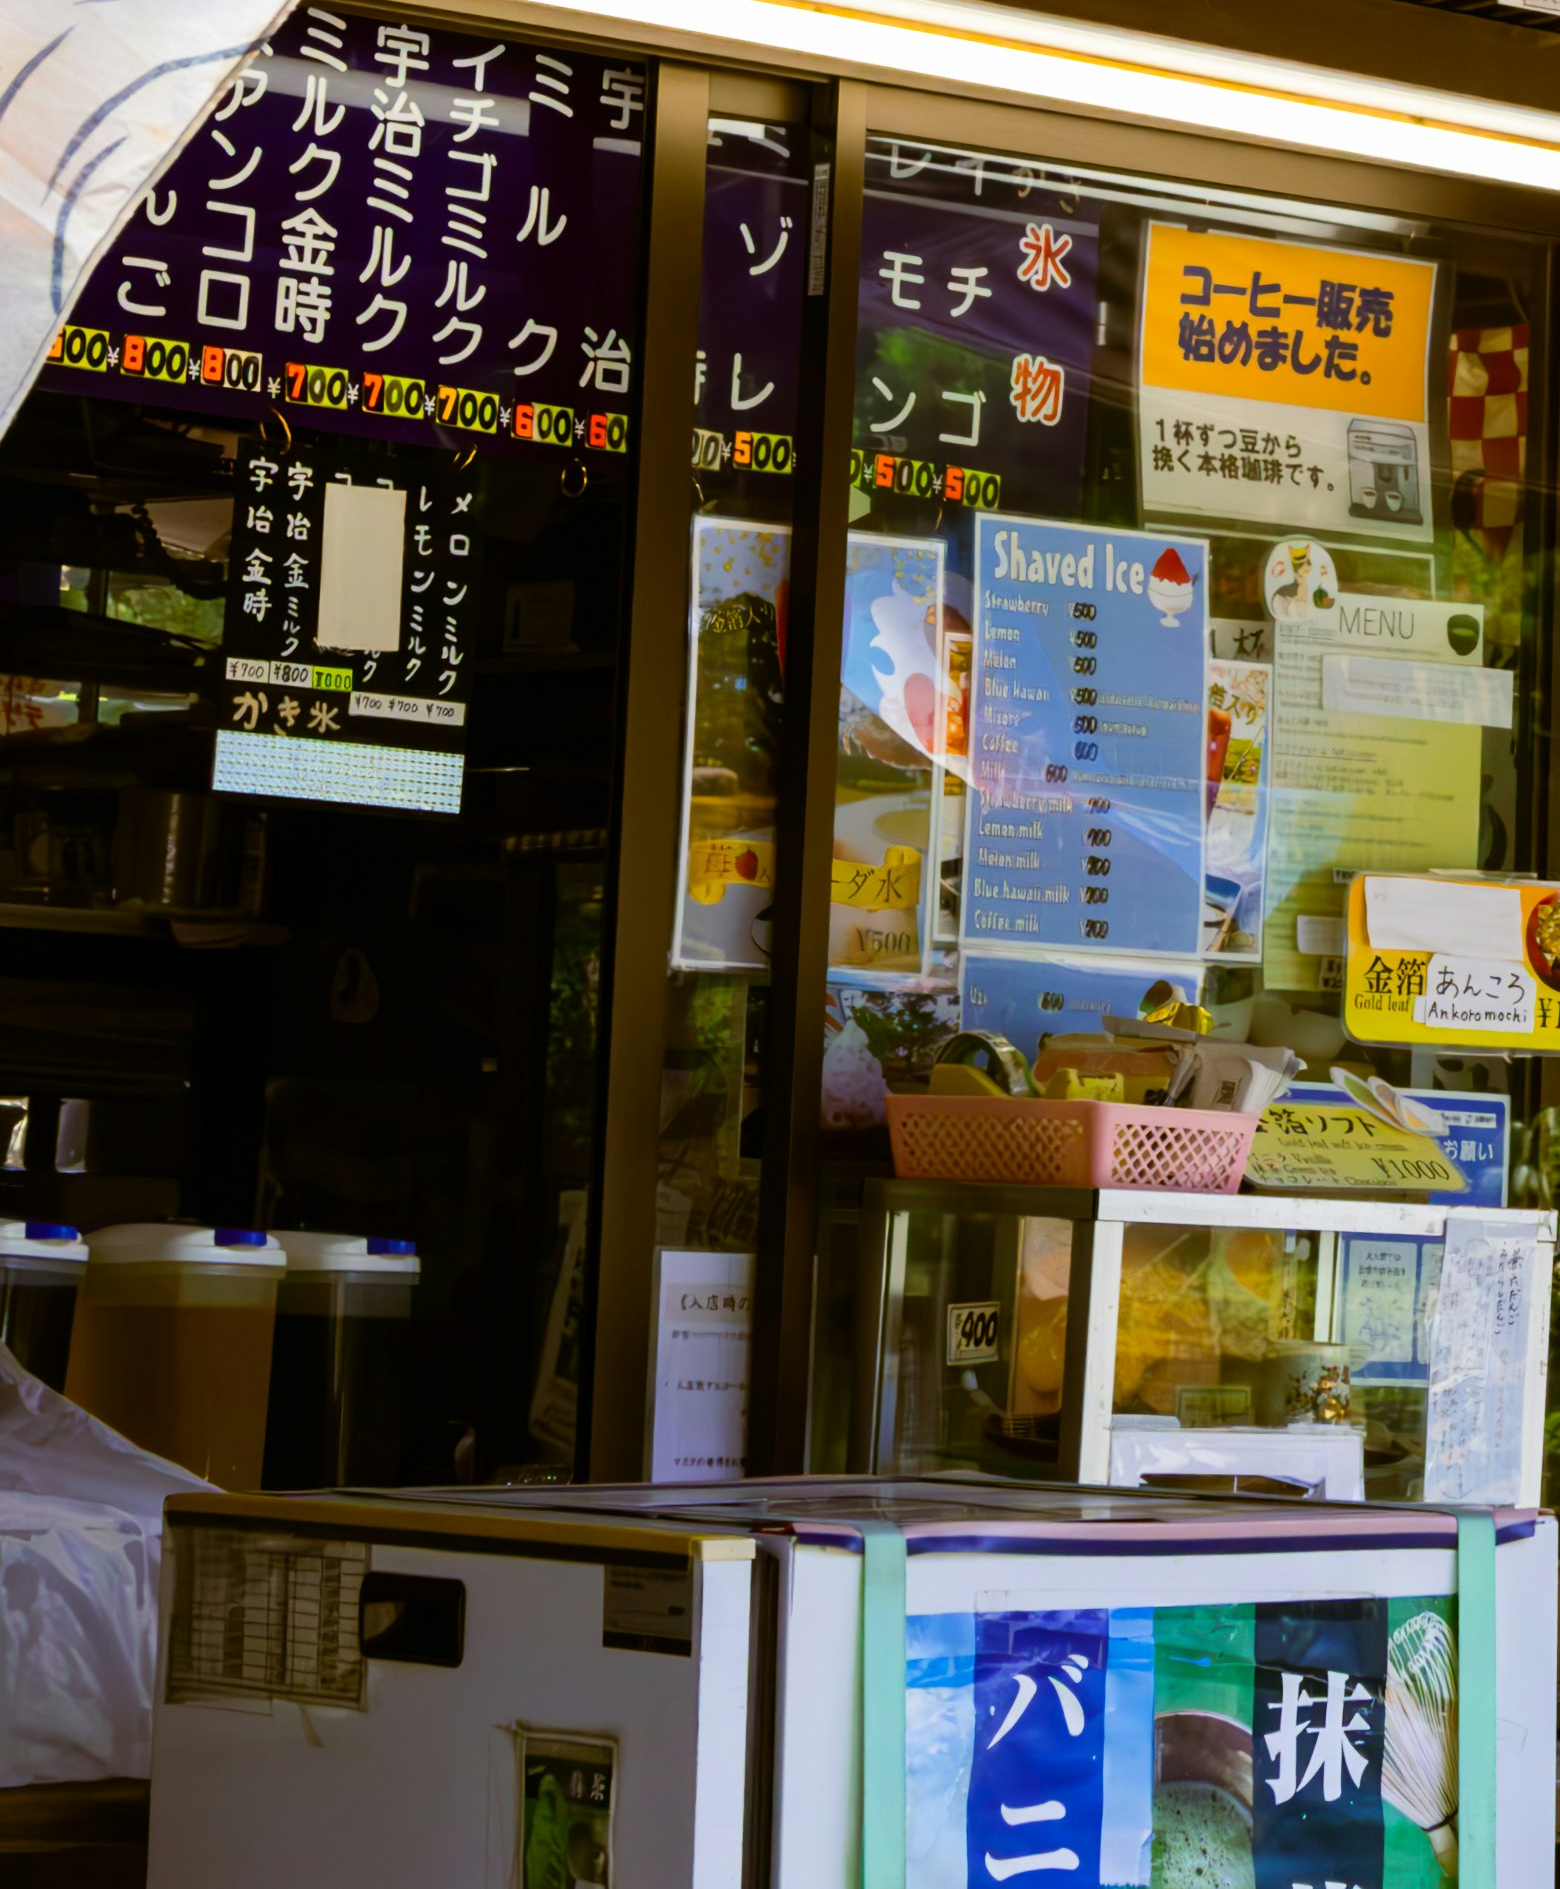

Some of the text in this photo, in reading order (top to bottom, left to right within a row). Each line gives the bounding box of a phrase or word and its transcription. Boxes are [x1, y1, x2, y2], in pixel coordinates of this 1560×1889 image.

[275, 6, 348, 344] ミルク金時
[355, 24, 430, 352] 宇治ミルク
[431, 43, 506, 365] イチゴミルク
[507, 53, 575, 377] ミルク
[1180, 265, 1394, 339] コーヒー販売
[107, 334, 186, 381] ¥800
[188, 344, 260, 390] ¥800
[1178, 311, 1372, 386] 始めました。
[267, 363, 346, 409] ¥700
[347, 372, 425, 419] ¥700
[424, 385, 498, 432] ¥700
[498, 402, 573, 447] ¥600
[1155, 418, 1302, 459] 1杯ずつ豆から
[721, 430, 792, 472] ¥500
[1152, 444, 1335, 492] 挽く本格珈琲です。
[864, 454, 935, 498] ¥500
[932, 464, 1000, 508] ¥500
[242, 456, 278, 623] 宇治金時
[281, 461, 313, 657] 宇治金ミルク
[994, 530, 1145, 595] Shaved Ice
[405, 485, 435, 682] レモンミルク
[438, 492, 473, 696] メロンミルク
[984, 590, 1049, 617] Strawberry
[984, 619, 1020, 643] Lemon
[1340, 606, 1415, 640] MENU
[229, 660, 265, 679] ¥700
[273, 662, 309, 683] ¥800
[232, 690, 342, 736] かき氷
[354, 694, 456, 719] ¥700 ¥700 ¥700
[974, 877, 999, 899] Blue
[1364, 954, 1426, 996] 金箔
[1436, 965, 1525, 1004] あんころ
[1354, 993, 1410, 1013] Gold leaf
[1371, 1158, 1450, 1181] ¥1000
